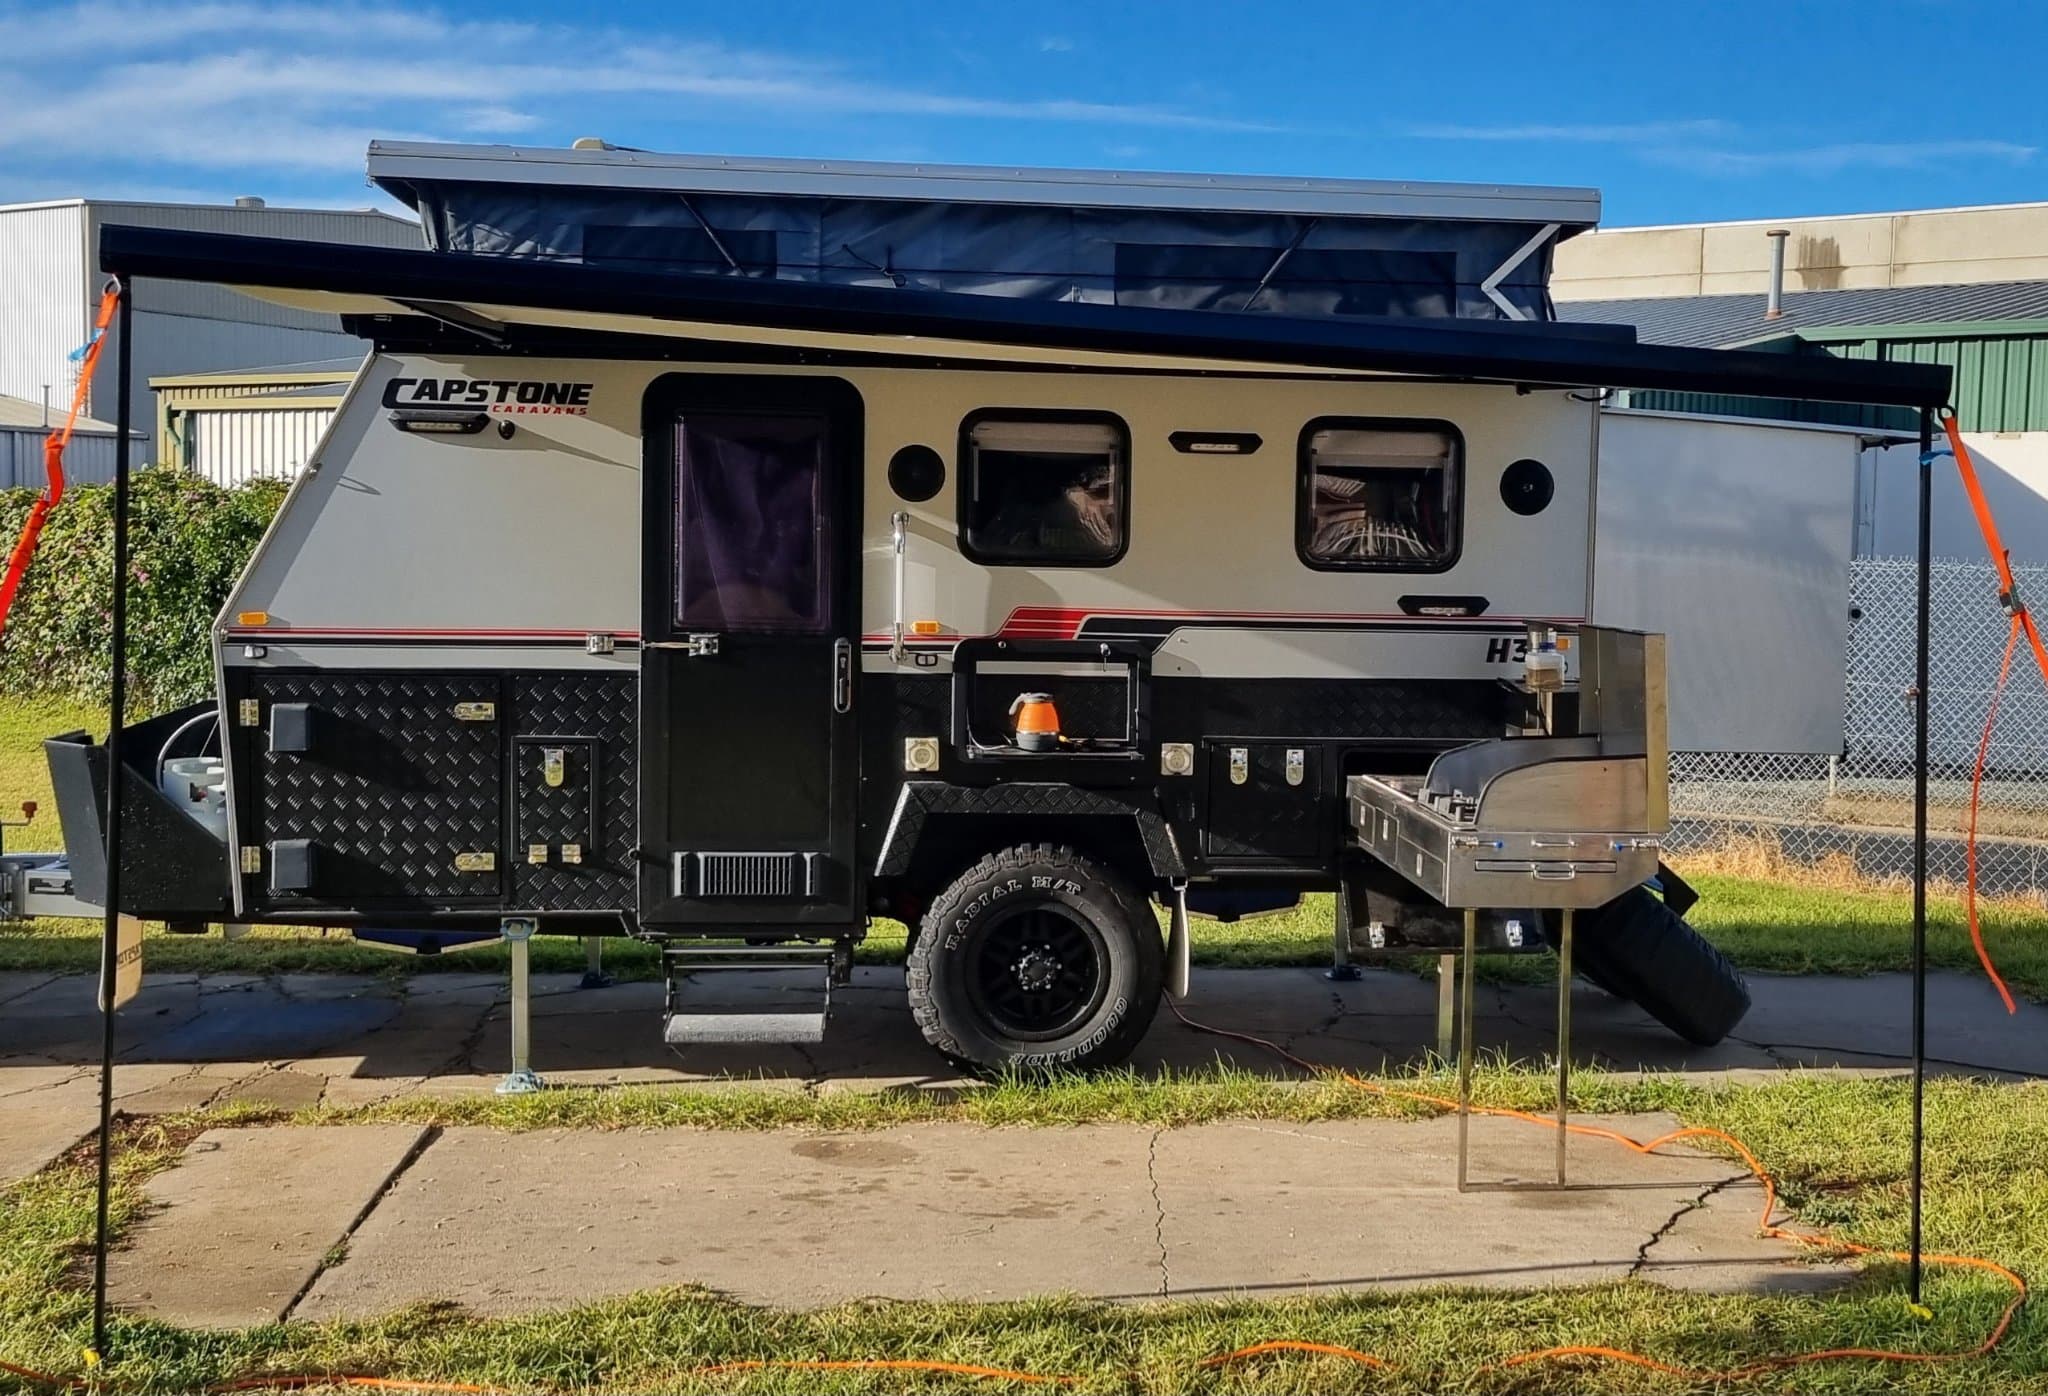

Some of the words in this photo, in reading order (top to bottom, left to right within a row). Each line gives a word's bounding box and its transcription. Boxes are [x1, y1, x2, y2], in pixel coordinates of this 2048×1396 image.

[381, 378, 593, 411] CAPSTONE
[492, 405, 587, 415] CARAVANS
[945, 880, 1022, 950] RADIAL
[1031, 876, 1081, 895] M/T
